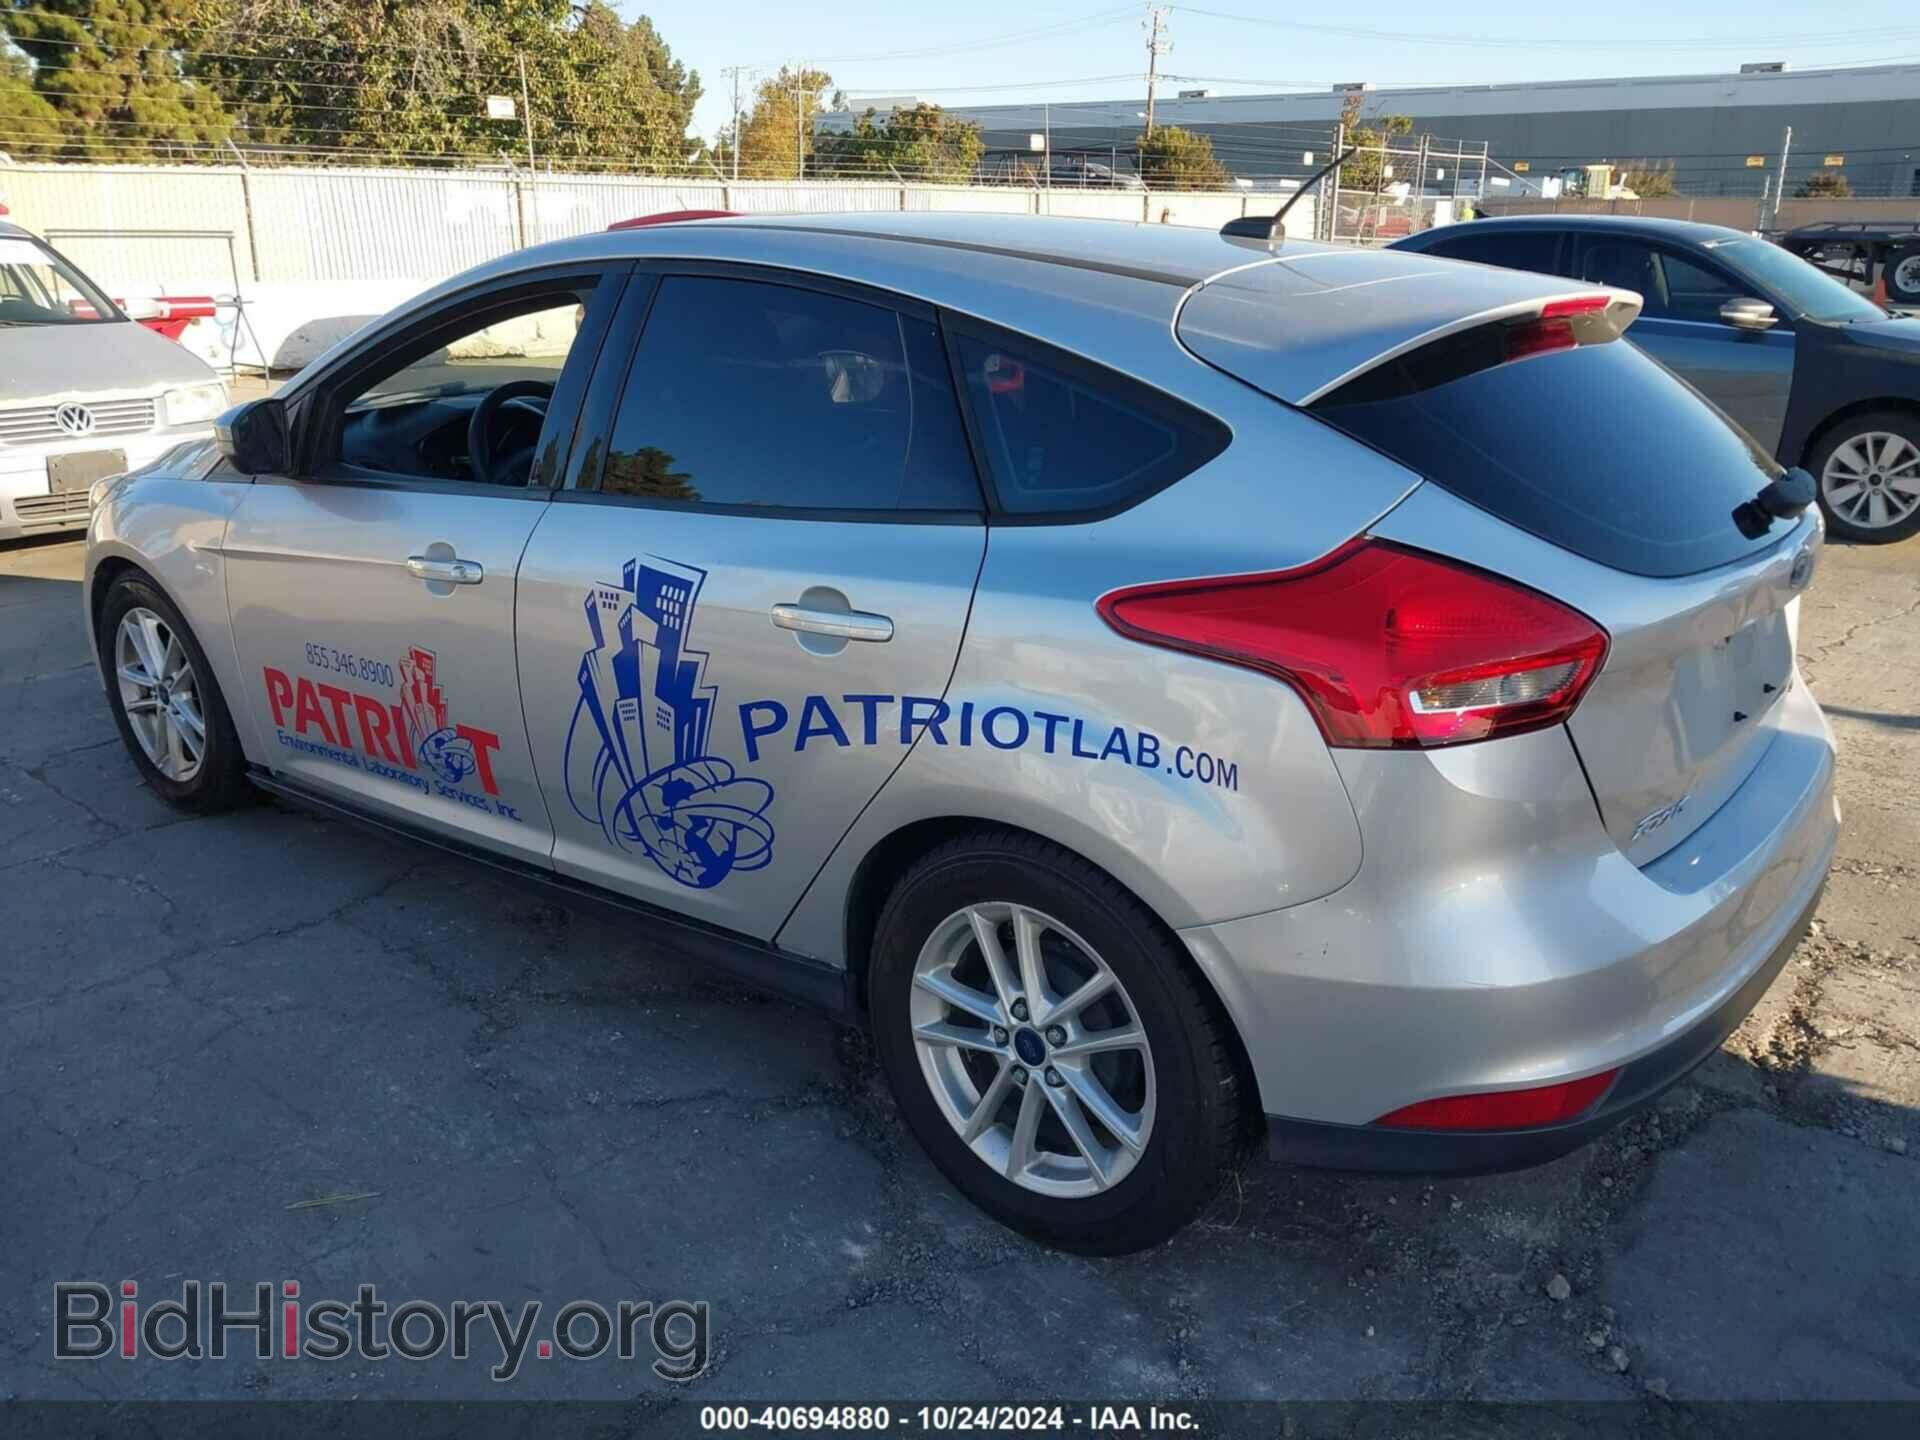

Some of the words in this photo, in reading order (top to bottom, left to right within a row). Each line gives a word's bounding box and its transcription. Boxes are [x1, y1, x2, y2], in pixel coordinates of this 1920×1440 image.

[305, 642, 394, 688] 855.346.8900
[738, 694, 1239, 792] PATRIOTLAB.COM
[495, 799, 522, 822] Inc.
